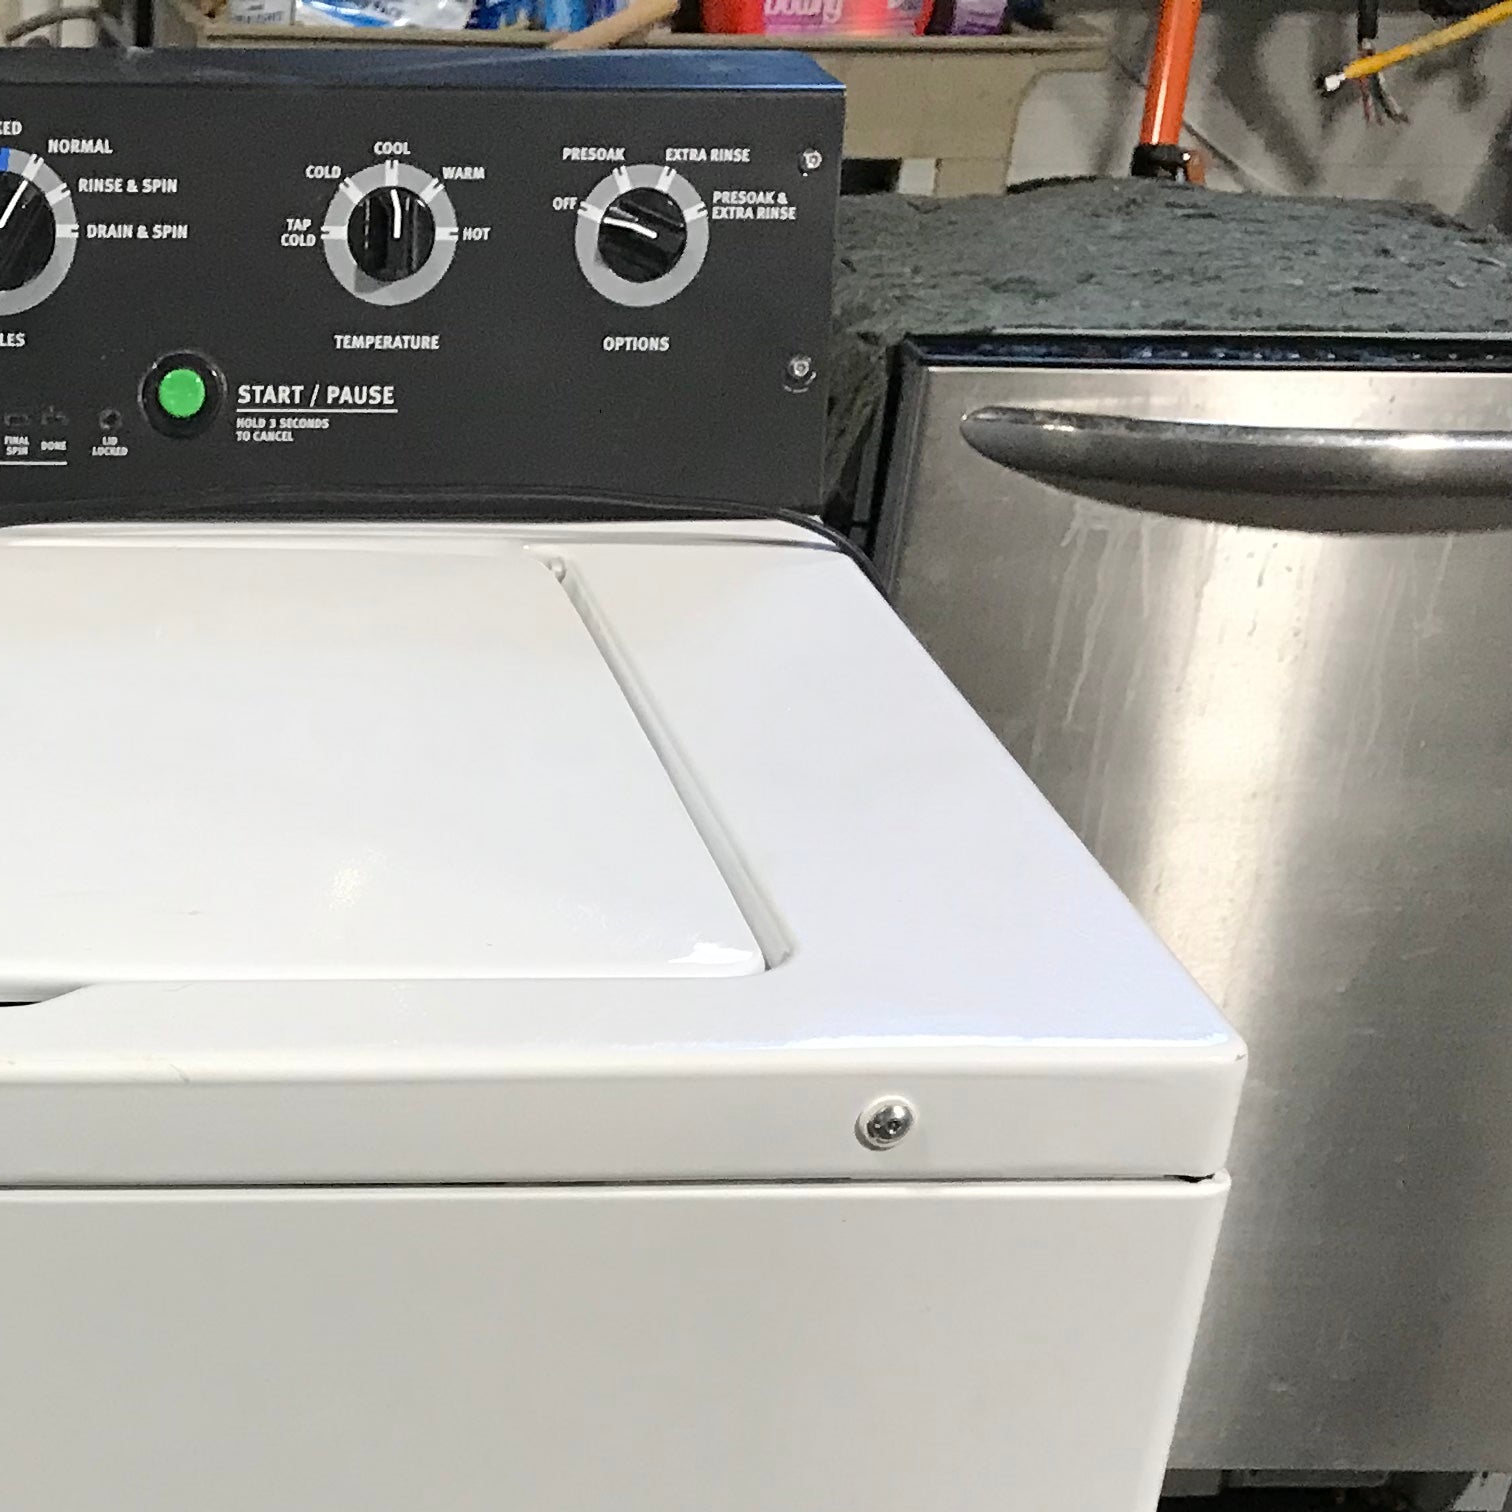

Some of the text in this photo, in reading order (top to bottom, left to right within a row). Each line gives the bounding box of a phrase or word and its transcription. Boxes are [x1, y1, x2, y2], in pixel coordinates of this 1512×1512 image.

[47, 138, 114, 155] NORMAL
[373, 141, 412, 156] COOL
[562, 146, 626, 162] PRESOAK
[665, 147, 751, 163] EXTRA RINSE
[305, 164, 342, 179] COLD
[442, 166, 486, 181] WARM
[78, 177, 178, 194] RINSE & SPIN
[552, 196, 579, 212] OFF
[712, 190, 789, 206] PRESOAK &
[711, 205, 797, 222] EXTRA RINSE
[86, 223, 189, 240] DRAIN & SPIN
[286, 218, 312, 232] TAP
[280, 232, 317, 247] COLD
[462, 226, 492, 241] HOT
[333, 334, 440, 350] TEMPERATURE
[602, 336, 670, 352] OPTIONS
[237, 383, 395, 408] START / PAUSE
[236, 417, 330, 429] HOLD 3 SECONDS
[235, 430, 294, 442] TO CANCEL
